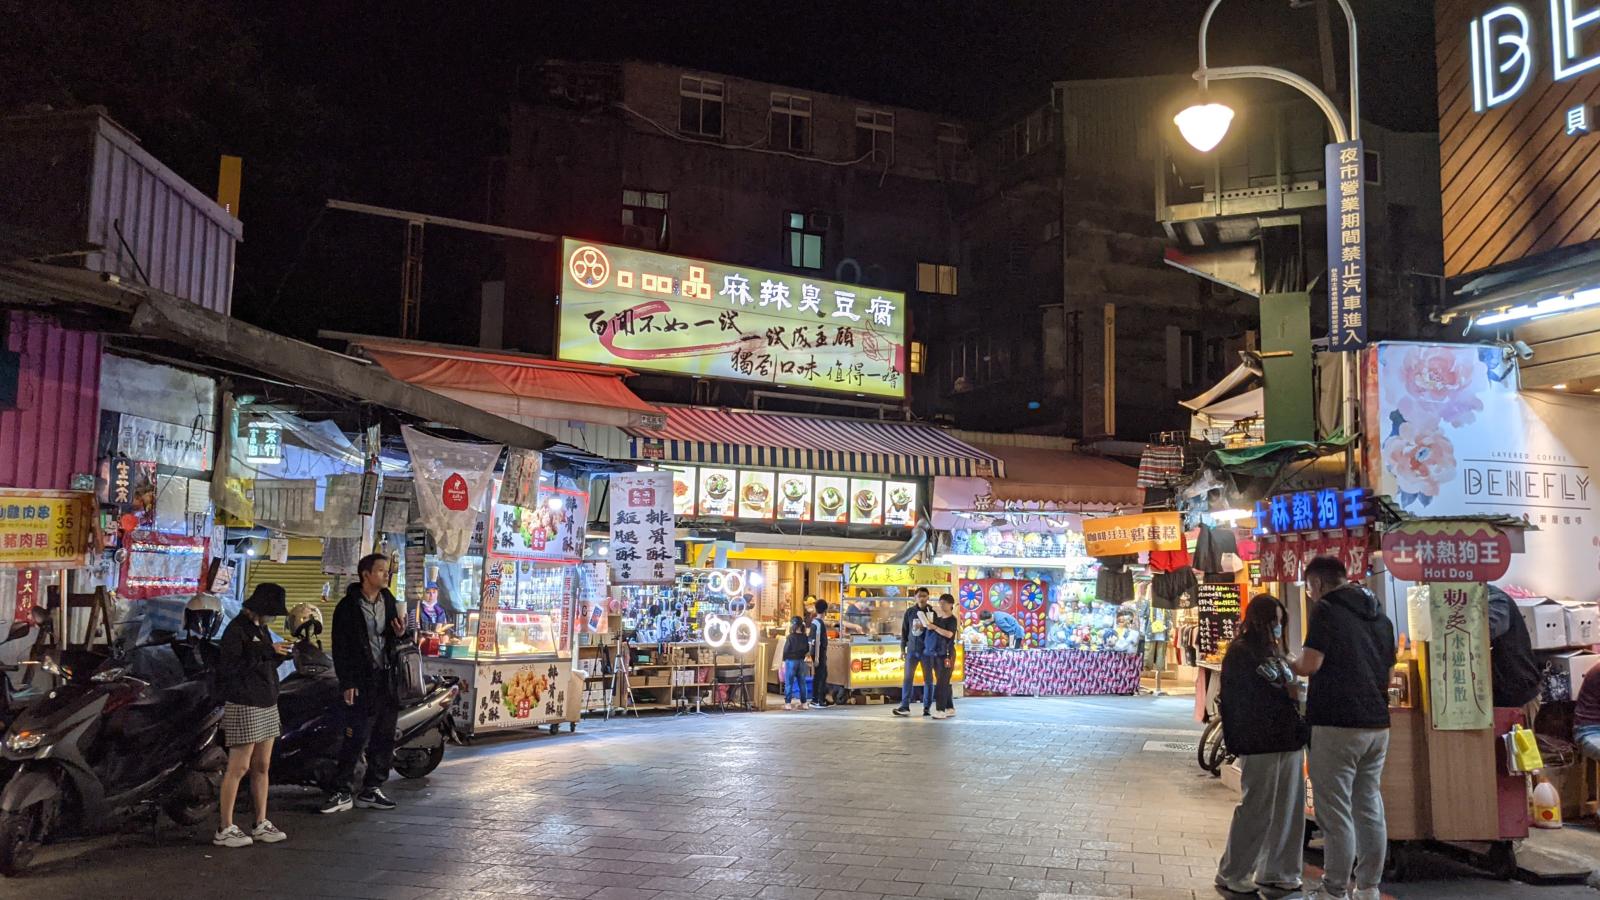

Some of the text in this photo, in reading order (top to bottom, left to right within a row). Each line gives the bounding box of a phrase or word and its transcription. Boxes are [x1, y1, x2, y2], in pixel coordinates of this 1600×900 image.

[1566, 104, 1587, 135] 貝
[1339, 147, 1363, 345] 夜市營業期間禁止汽車進入
[719, 273, 896, 327] 麻辣臭豆腐
[1463, 468, 1589, 501] BENEFLY
[56, 517, 74, 529] 35
[1252, 487, 1367, 537] 士林熱狗王
[645, 508, 673, 561] 排骨酥
[54, 546, 74, 558] 100
[1392, 540, 1500, 564] 士林熱狗王
[1424, 568, 1474, 579] Hot Dog
